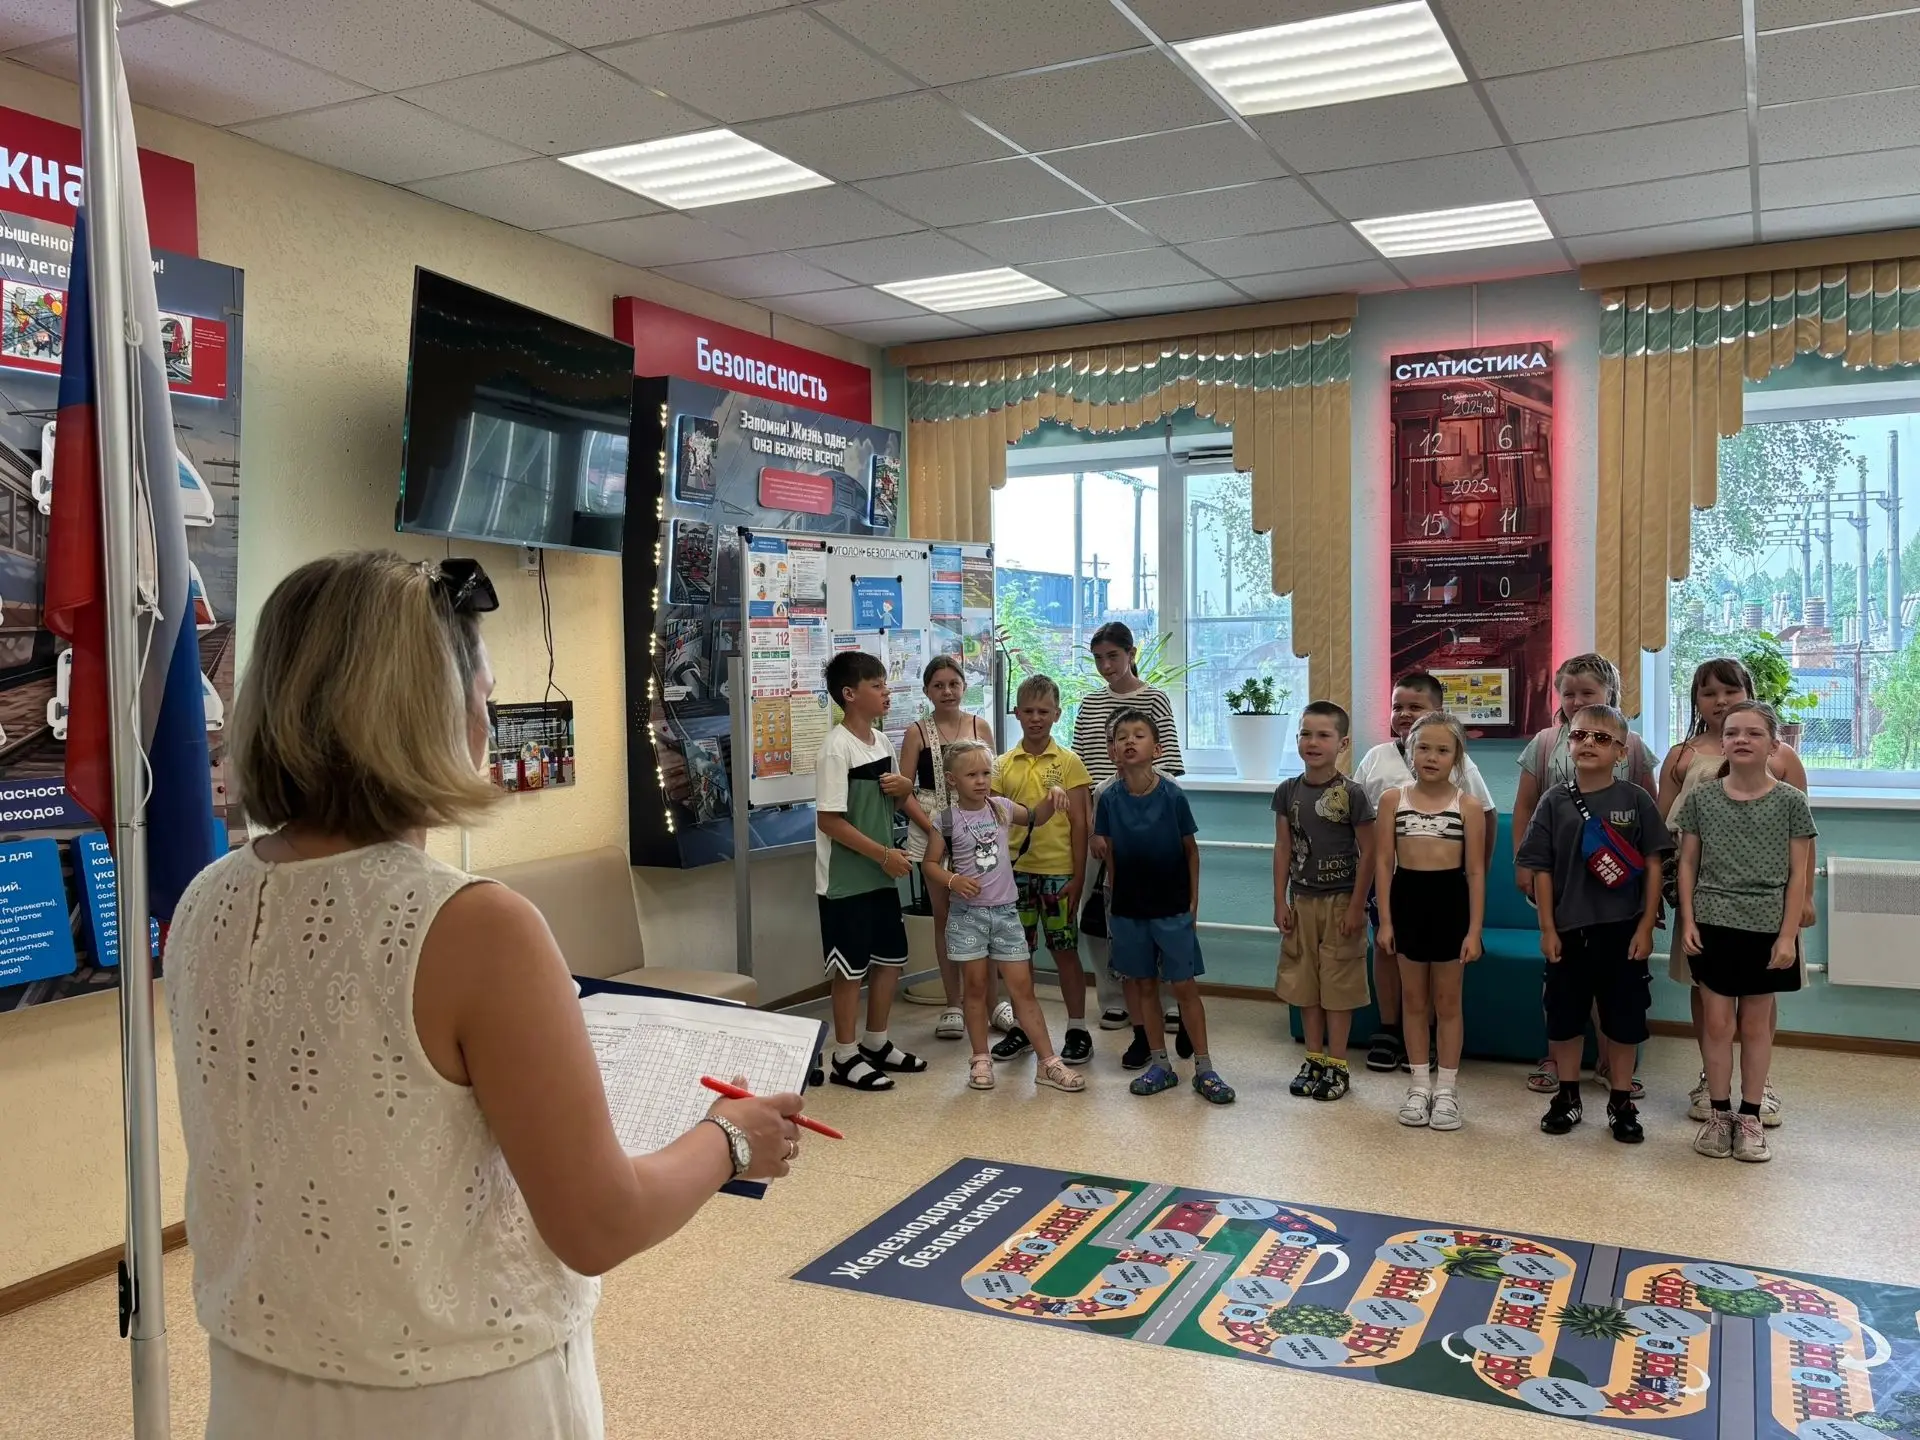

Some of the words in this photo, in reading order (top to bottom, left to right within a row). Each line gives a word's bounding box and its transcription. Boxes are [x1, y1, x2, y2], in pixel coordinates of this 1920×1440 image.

[697, 337, 828, 402] Безопасность
[1396, 352, 1547, 380] СТАТИСТИКА
[1453, 400, 1482, 416] 2024
[739, 410, 790, 436] Запомни!
[790, 420, 823, 445] Жизнь
[824, 431, 847, 450] одна
[1498, 424, 1512, 449] 6
[752, 437, 773, 453] она
[774, 440, 813, 461] важнее
[814, 445, 844, 466] всего!
[1420, 432, 1445, 455] 12
[1452, 478, 1489, 495] 2025
[1421, 510, 1442, 536] 15
[1500, 507, 1517, 532] 11
[833, 546, 863, 556] УГОЛОК
[866, 547, 923, 560] БЕЗОПАСНОСТИ
[1499, 576, 1510, 598] 0
[776, 631, 790, 646] 112
[0, 806, 65, 821] еходов
[9, 851, 33, 862] для
[1318, 859, 1347, 870] LION
[1317, 869, 1350, 882] KING
[2, 898, 58, 914] (турникеты),
[16, 930, 54, 942] полевые
[829, 1166, 1004, 1281] Железнодорожная
[898, 1186, 1024, 1269] безопасность
